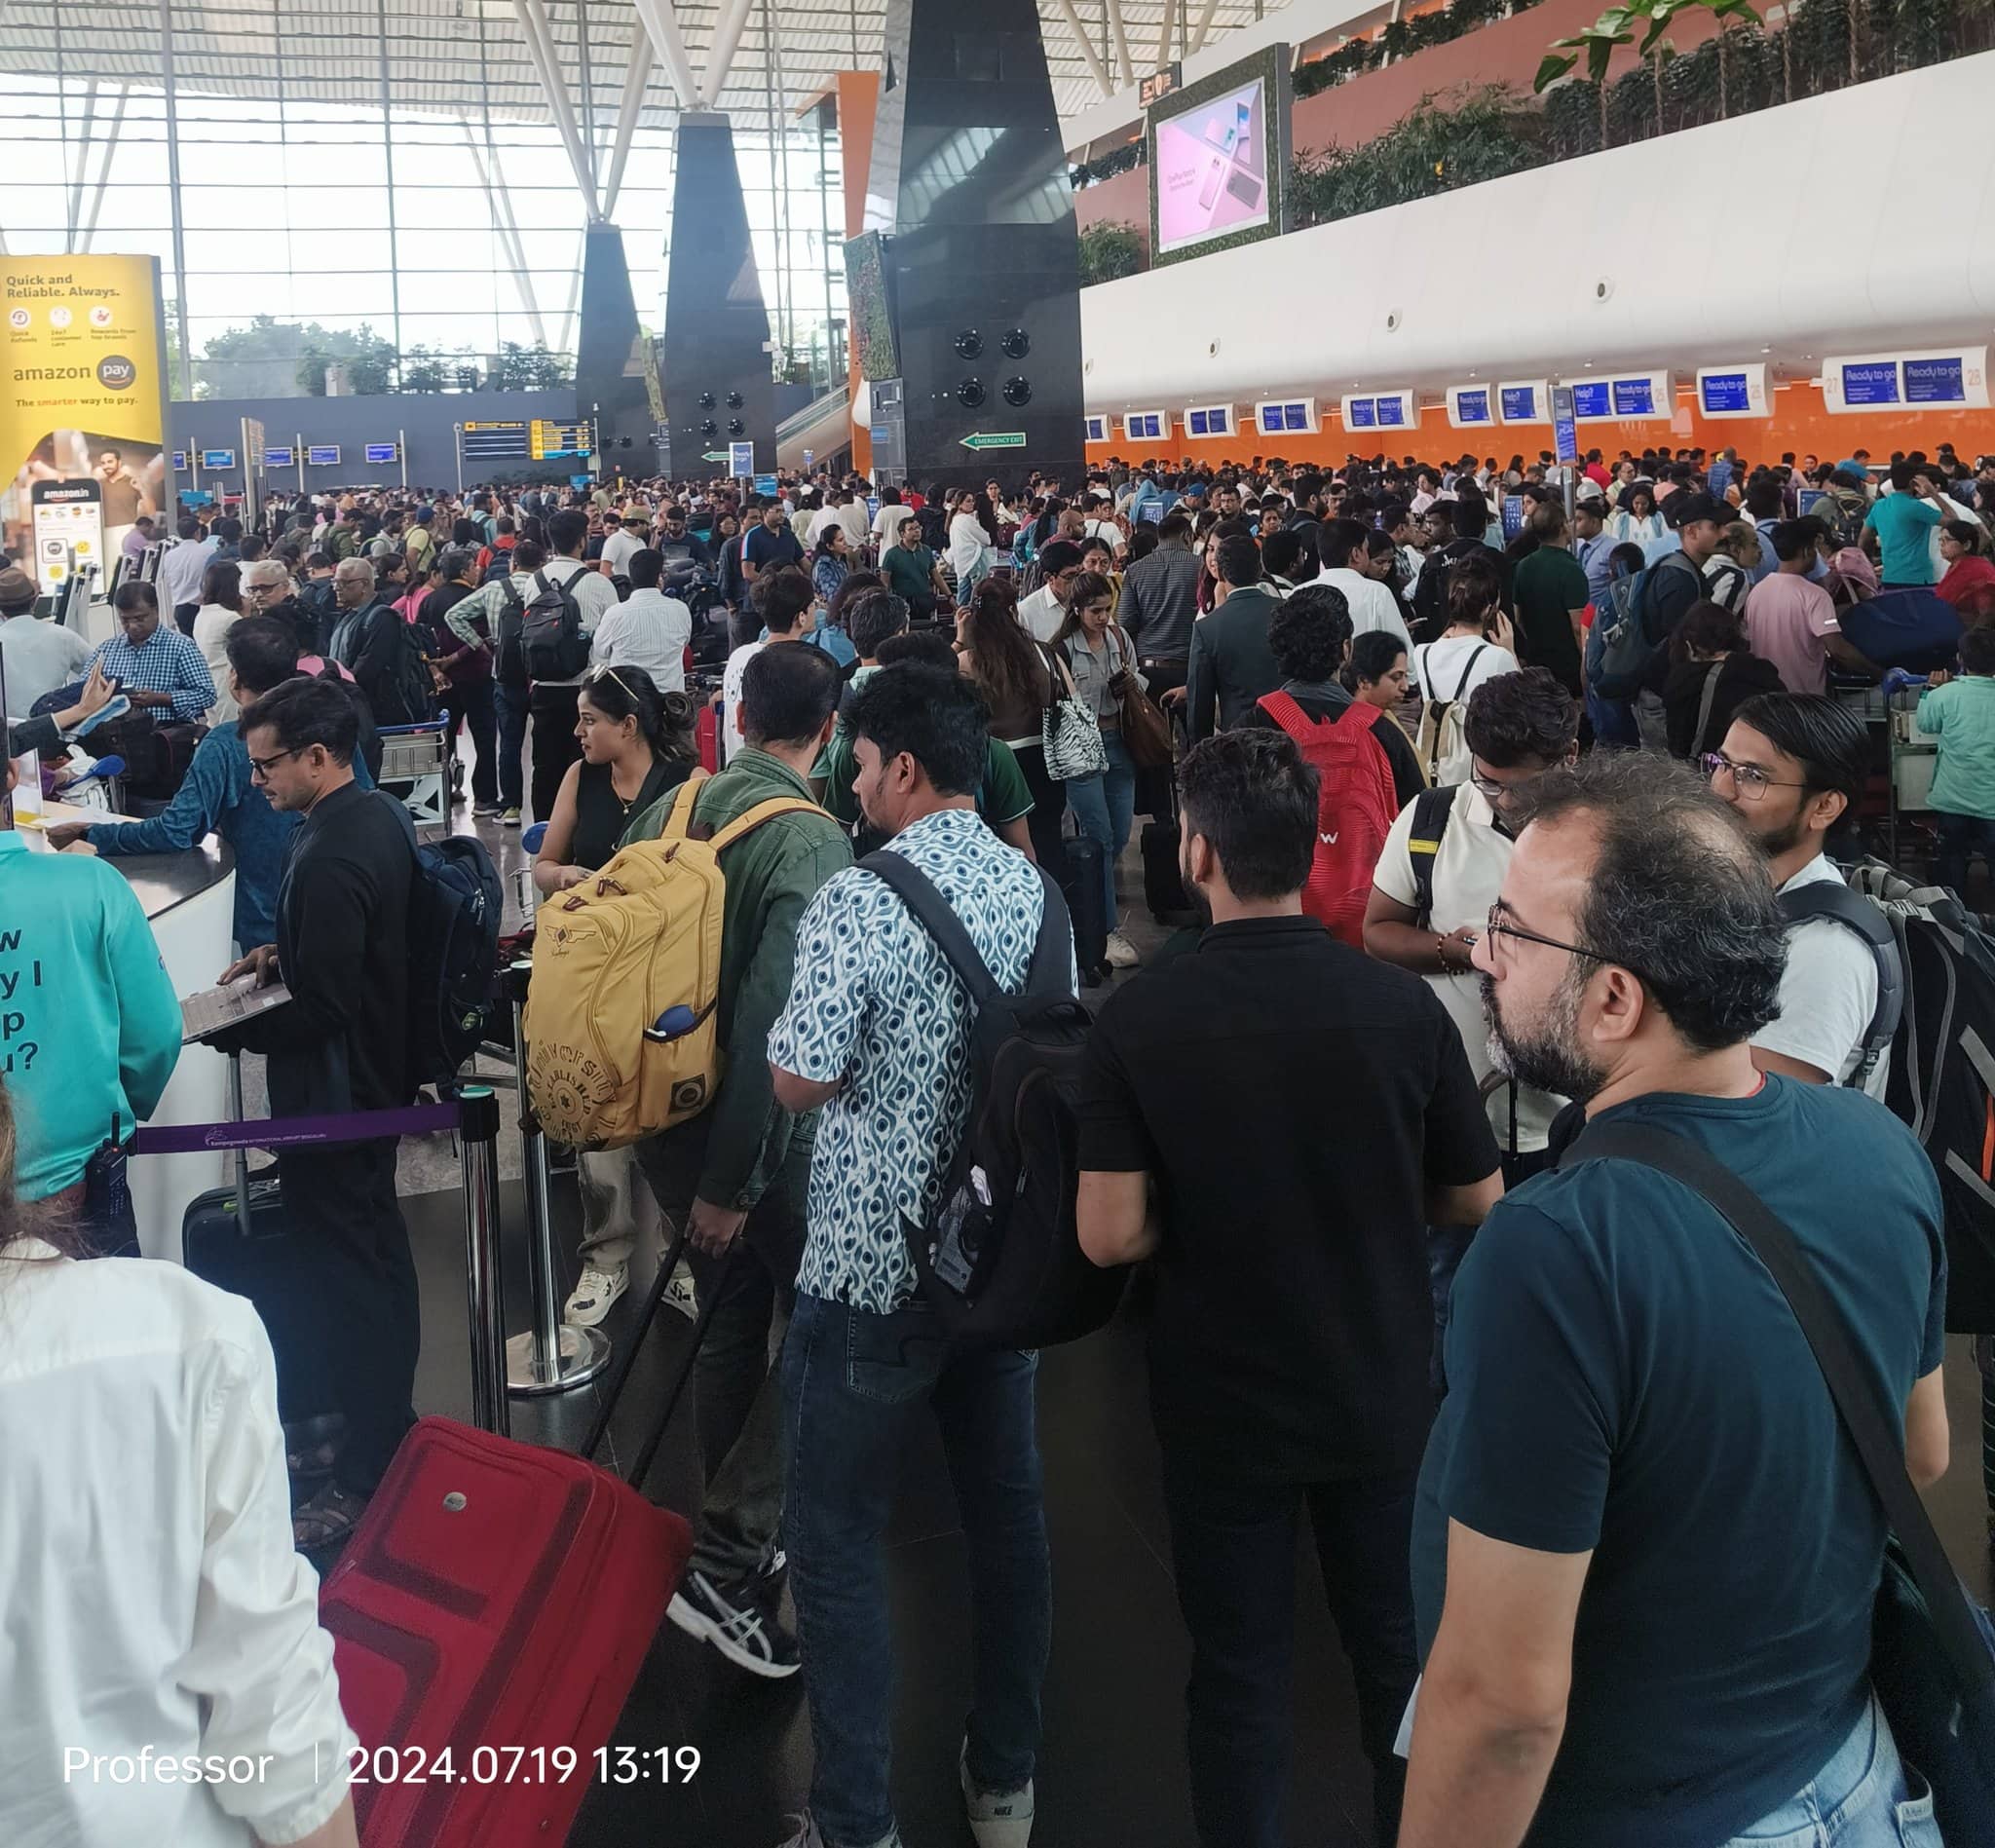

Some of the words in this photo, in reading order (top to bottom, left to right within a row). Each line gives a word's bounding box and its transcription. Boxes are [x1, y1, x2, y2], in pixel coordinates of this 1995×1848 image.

[7, 275, 45, 286] Quick
[48, 274, 73, 284] and
[7, 287, 65, 298] Reliable.
[69, 286, 120, 298] Always.
[14, 366, 91, 381] amazon
[102, 364, 130, 378] pay
[1846, 368, 1873, 382] Ready
[1873, 370, 1883, 380] to
[1883, 369, 1896, 382] go
[1907, 366, 1936, 379] Ready
[1937, 365, 1946, 376] to
[1947, 365, 1961, 379] go
[16, 398, 34, 407] The
[80, 397, 101, 406] way
[974, 436, 1009, 445] EMERGENCY
[1010, 435, 1023, 444] EXIT
